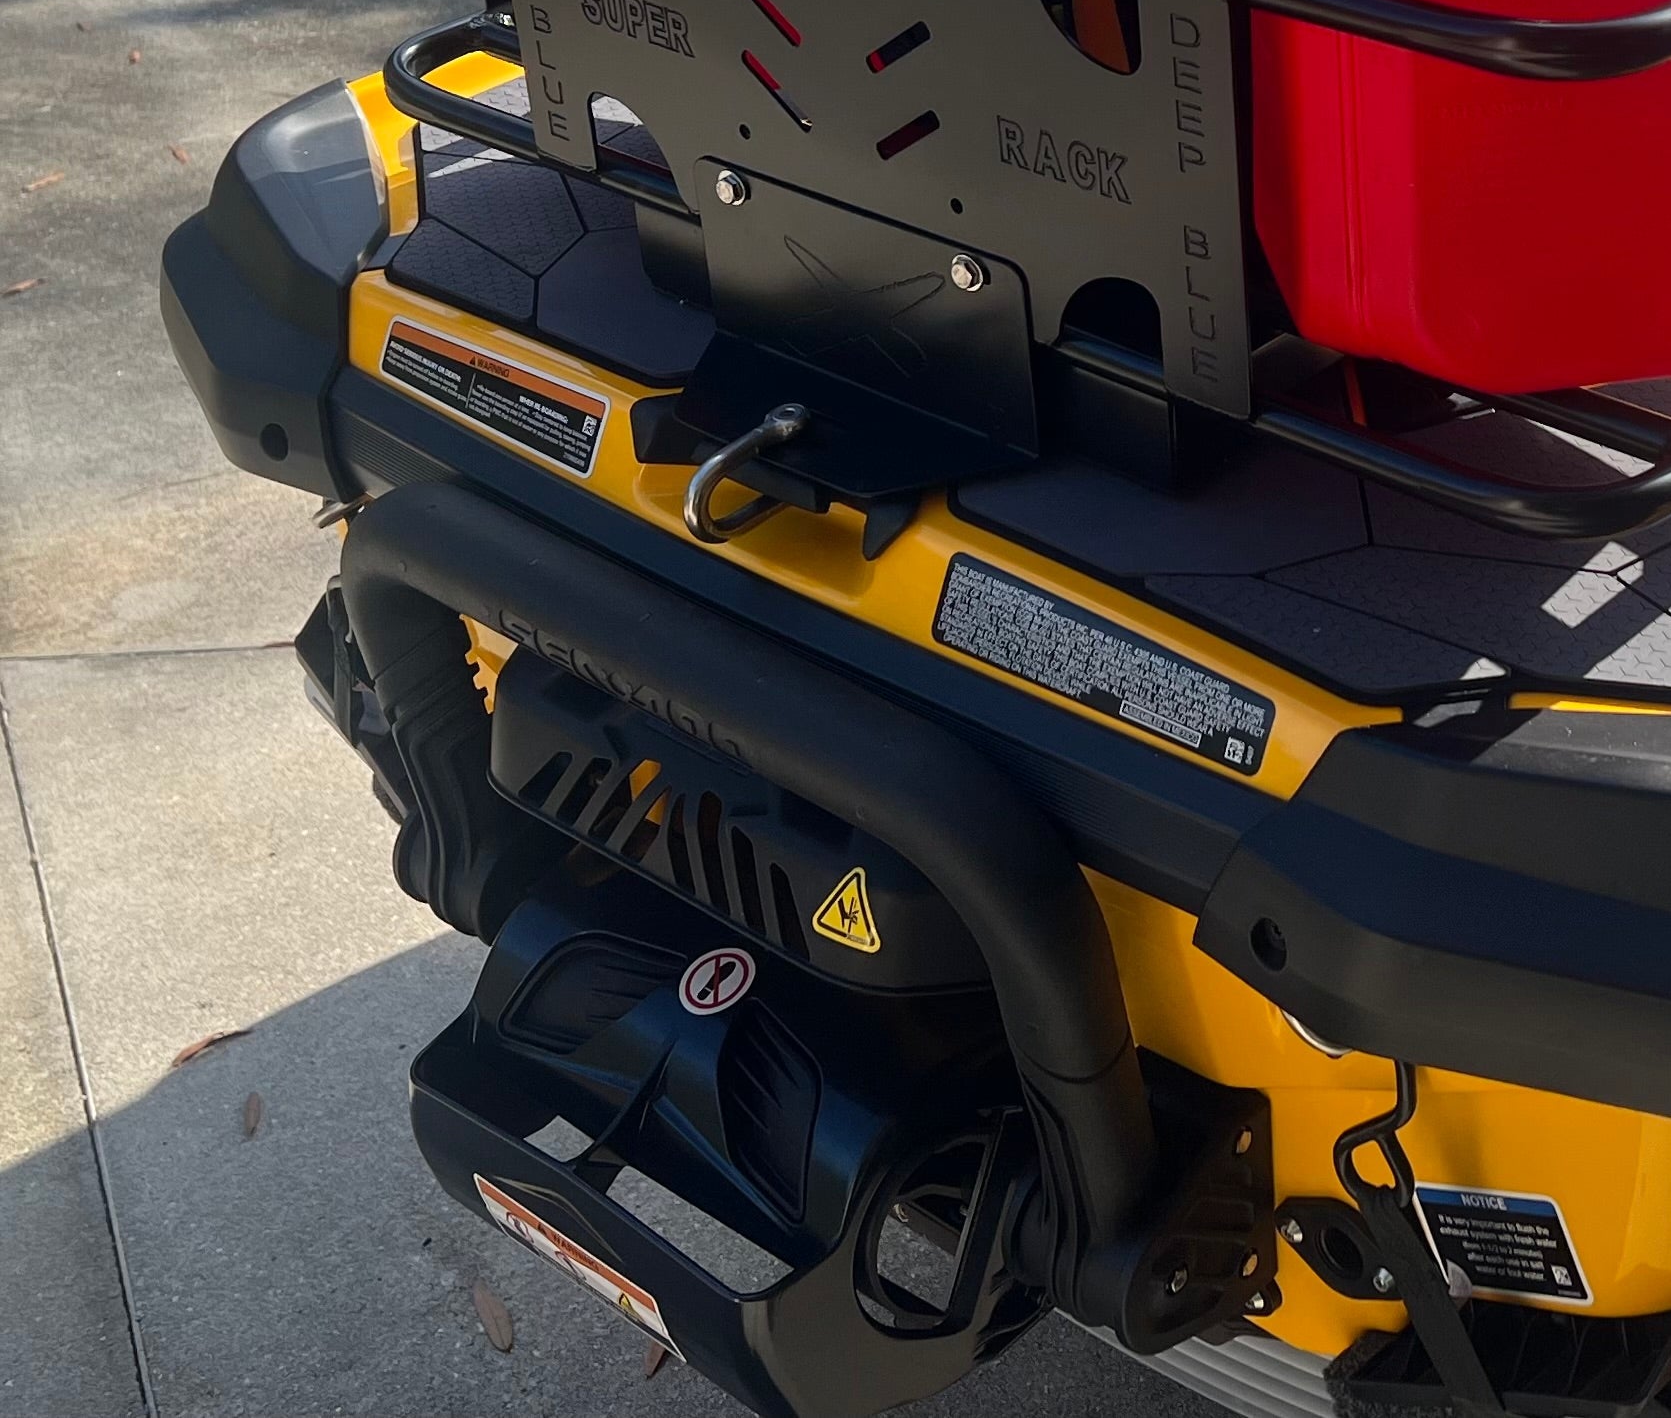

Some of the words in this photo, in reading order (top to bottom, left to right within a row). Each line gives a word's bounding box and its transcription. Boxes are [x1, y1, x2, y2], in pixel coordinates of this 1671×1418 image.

[530, 4, 570, 142] BLUE
[1169, 12, 1207, 173] DEEP
[996, 114, 1132, 205] RACK
[1183, 224, 1218, 383] BLUE
[1458, 1192, 1509, 1211] NOTICE
